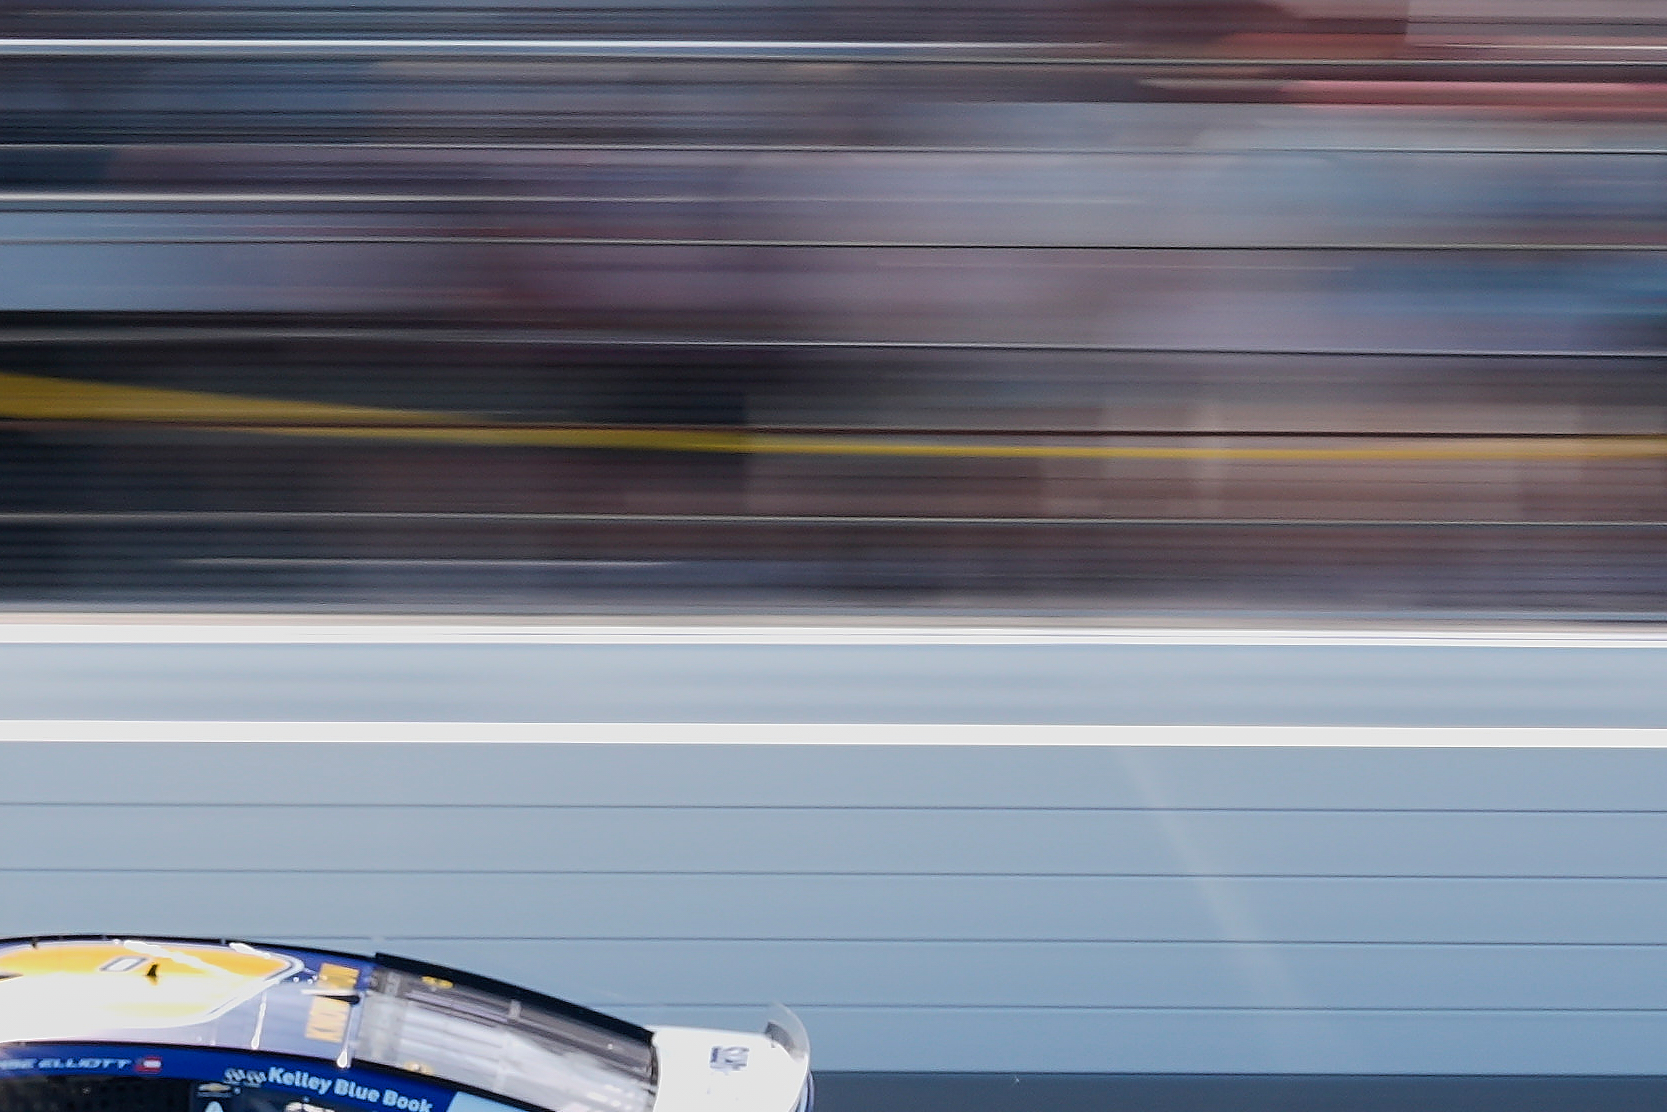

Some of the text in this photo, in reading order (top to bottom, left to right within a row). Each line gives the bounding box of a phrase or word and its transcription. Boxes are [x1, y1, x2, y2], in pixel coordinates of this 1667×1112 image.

[38, 1057, 131, 1069] ELLIOTT
[268, 1067, 332, 1095] Kelley
[334, 1078, 380, 1102] Blue
